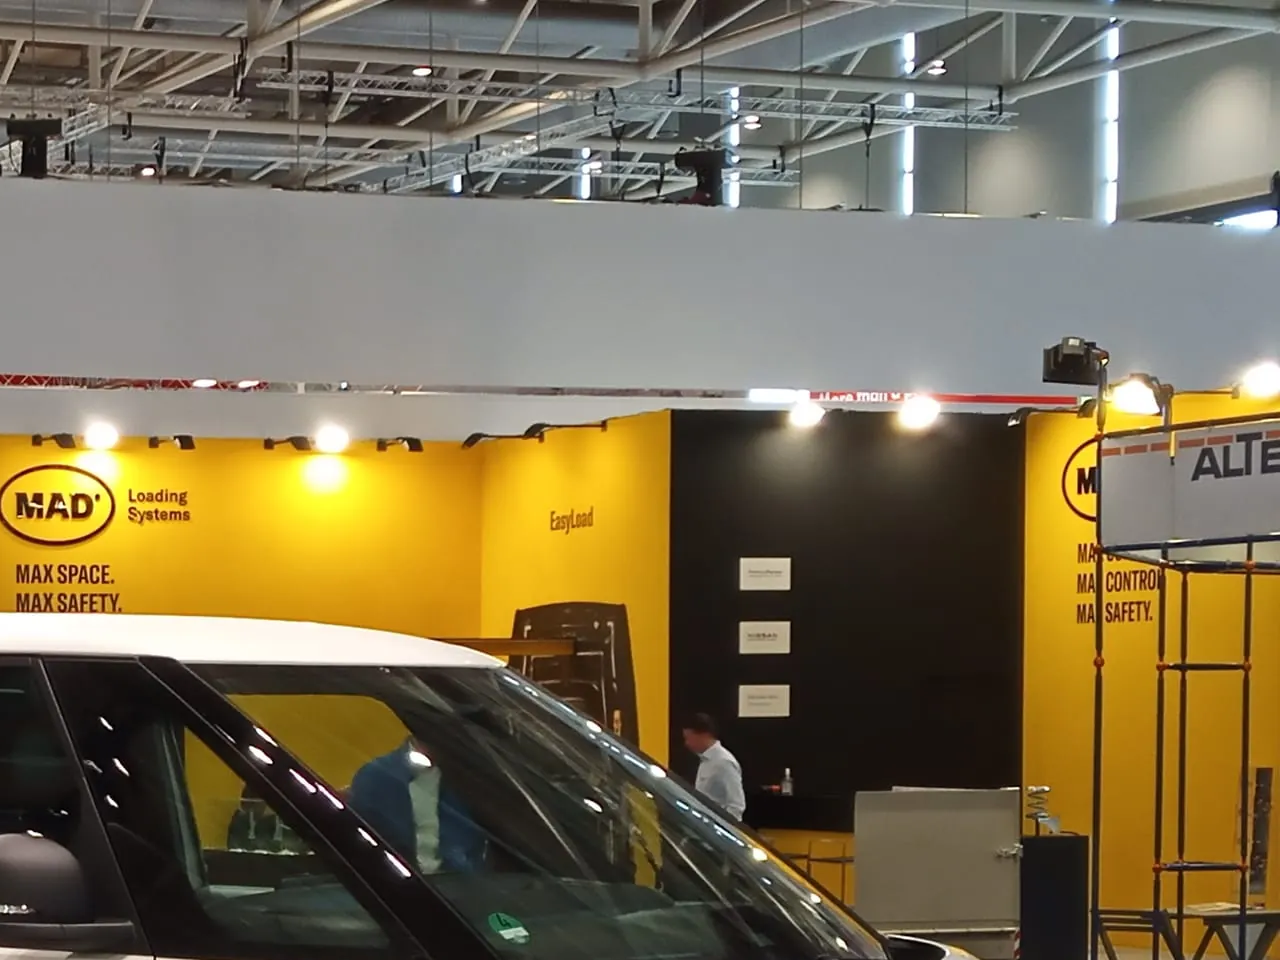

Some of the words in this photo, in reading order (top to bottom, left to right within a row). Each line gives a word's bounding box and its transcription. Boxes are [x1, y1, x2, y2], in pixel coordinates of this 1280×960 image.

[16, 492, 94, 519] MAD
[128, 489, 188, 506] Loading
[128, 507, 190, 525] Systems
[550, 506, 594, 535] EasyLoad
[16, 564, 53, 584] MAX
[57, 564, 115, 584] SPACE.
[1076, 573, 1097, 594] MA
[16, 593, 53, 612] MAX
[57, 593, 122, 612] SAFETY.
[1076, 604, 1097, 624] MA
[1105, 601, 1153, 624] SAFETY.
